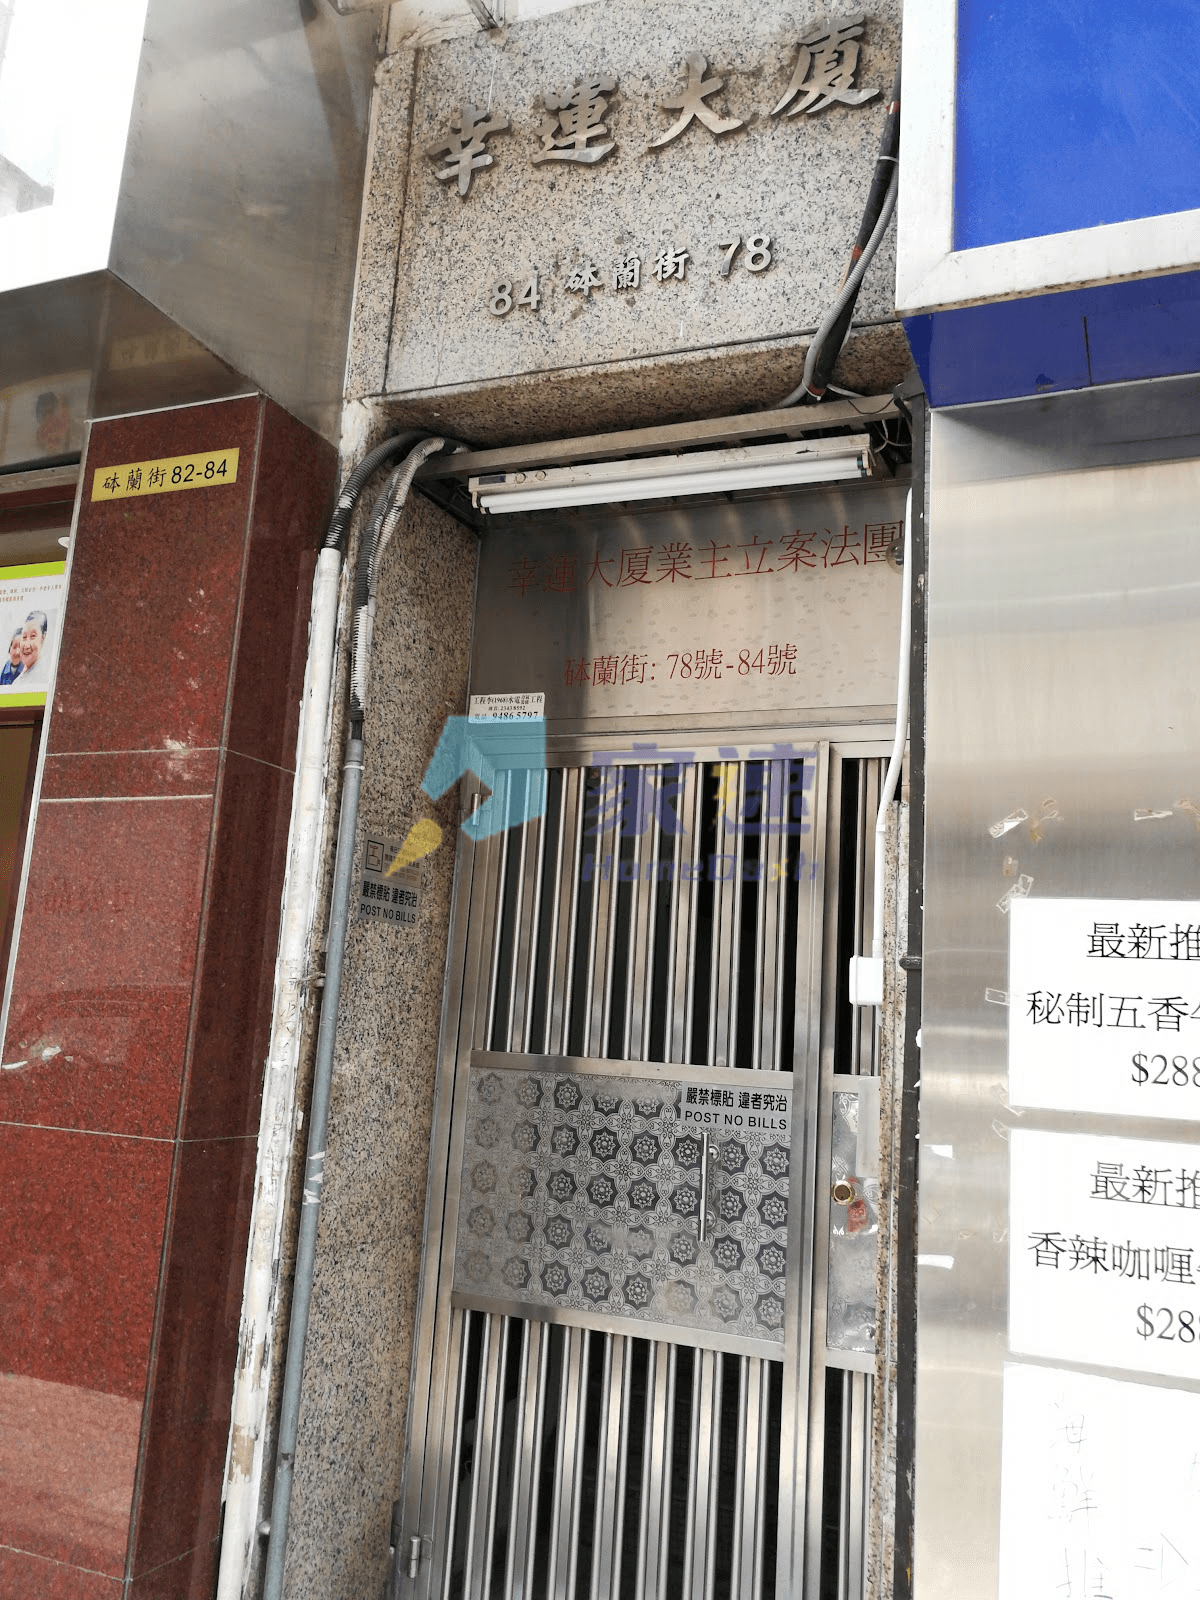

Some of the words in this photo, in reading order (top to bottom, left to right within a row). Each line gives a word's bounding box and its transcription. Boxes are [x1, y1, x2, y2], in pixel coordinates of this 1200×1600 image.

[489, 265, 542, 316] 84
[564, 246, 690, 297] 砵蘭街
[717, 232, 772, 277] 78
[360, 903, 382, 917] POST
[382, 908, 394, 920] NO
[395, 910, 416, 924] BILLS
[686, 1086, 734, 1108] 嚴禁標貼
[738, 1091, 788, 1112] 違者究治
[684, 1110, 720, 1124] POST
[724, 1114, 744, 1126] NO
[748, 1116, 787, 1130] BILLS
[1026, 1231, 1200, 1284] 香辣咖喱
